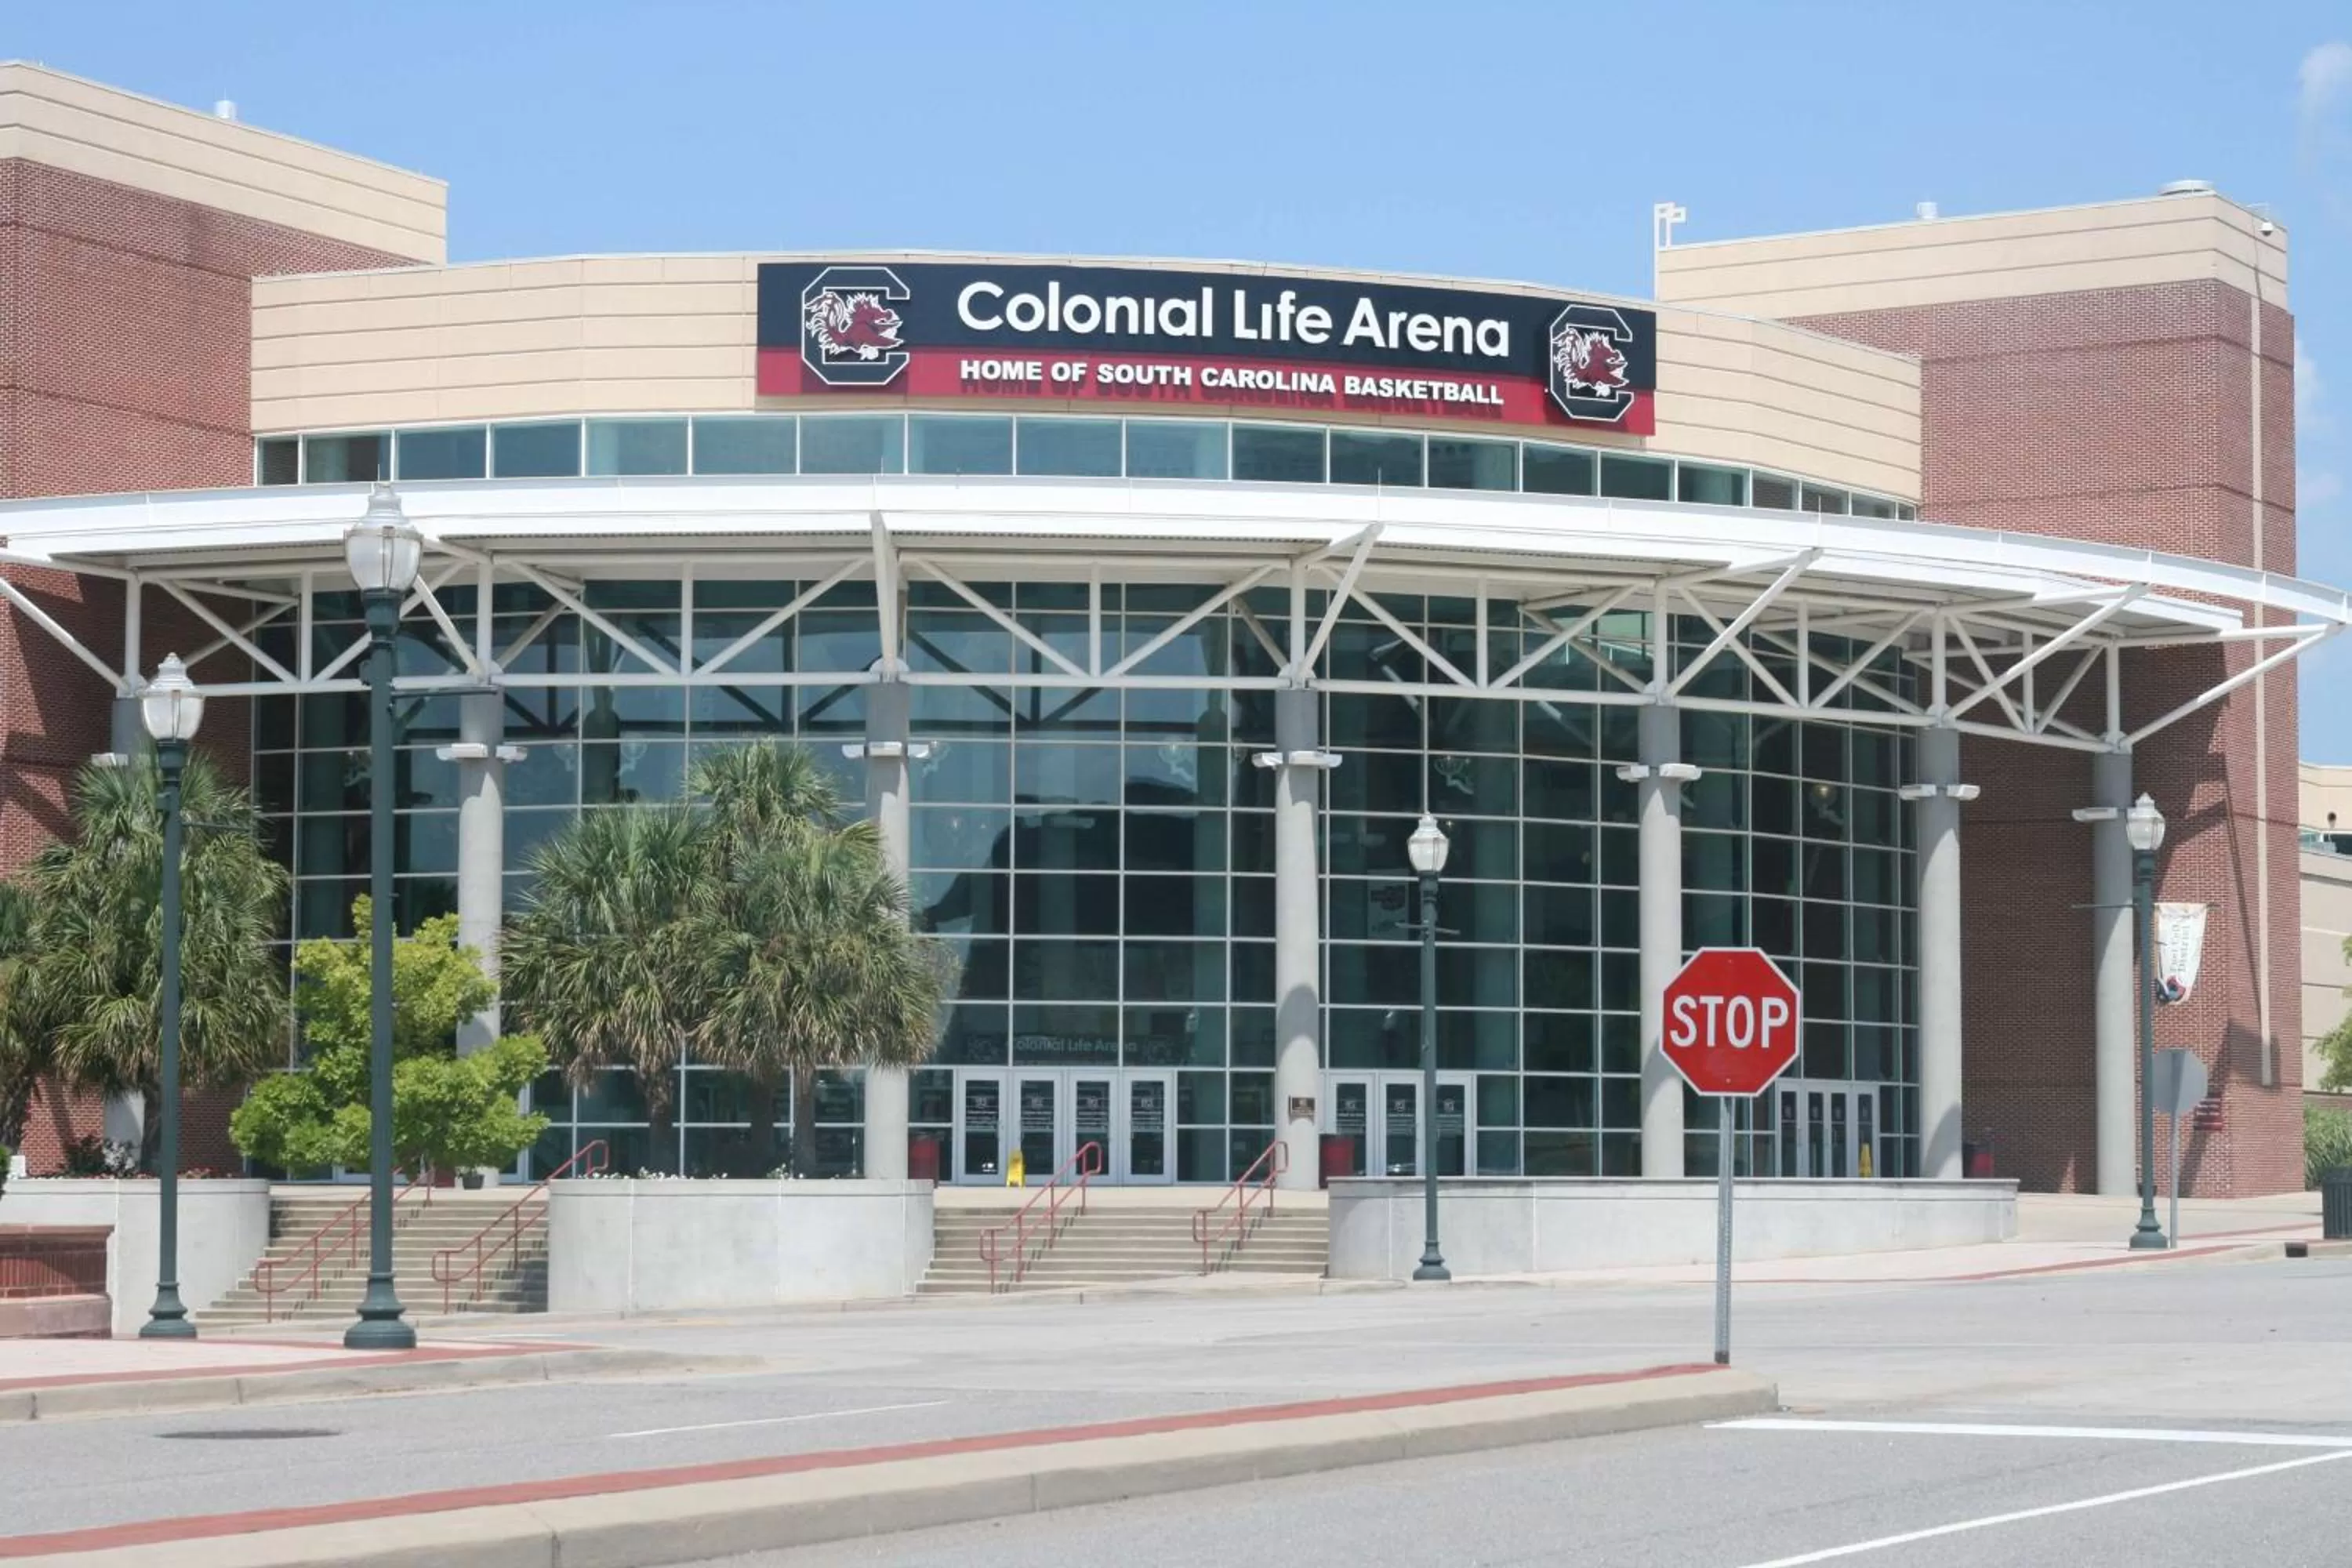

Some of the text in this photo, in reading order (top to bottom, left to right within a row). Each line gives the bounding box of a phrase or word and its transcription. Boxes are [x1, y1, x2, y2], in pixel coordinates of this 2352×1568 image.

[957, 281, 1510, 358] Colonial Life Arena
[960, 360, 1504, 405] HOME OF SOUTH CAROLINA BASKETBALL
[1669, 995, 1789, 1048] STOP
